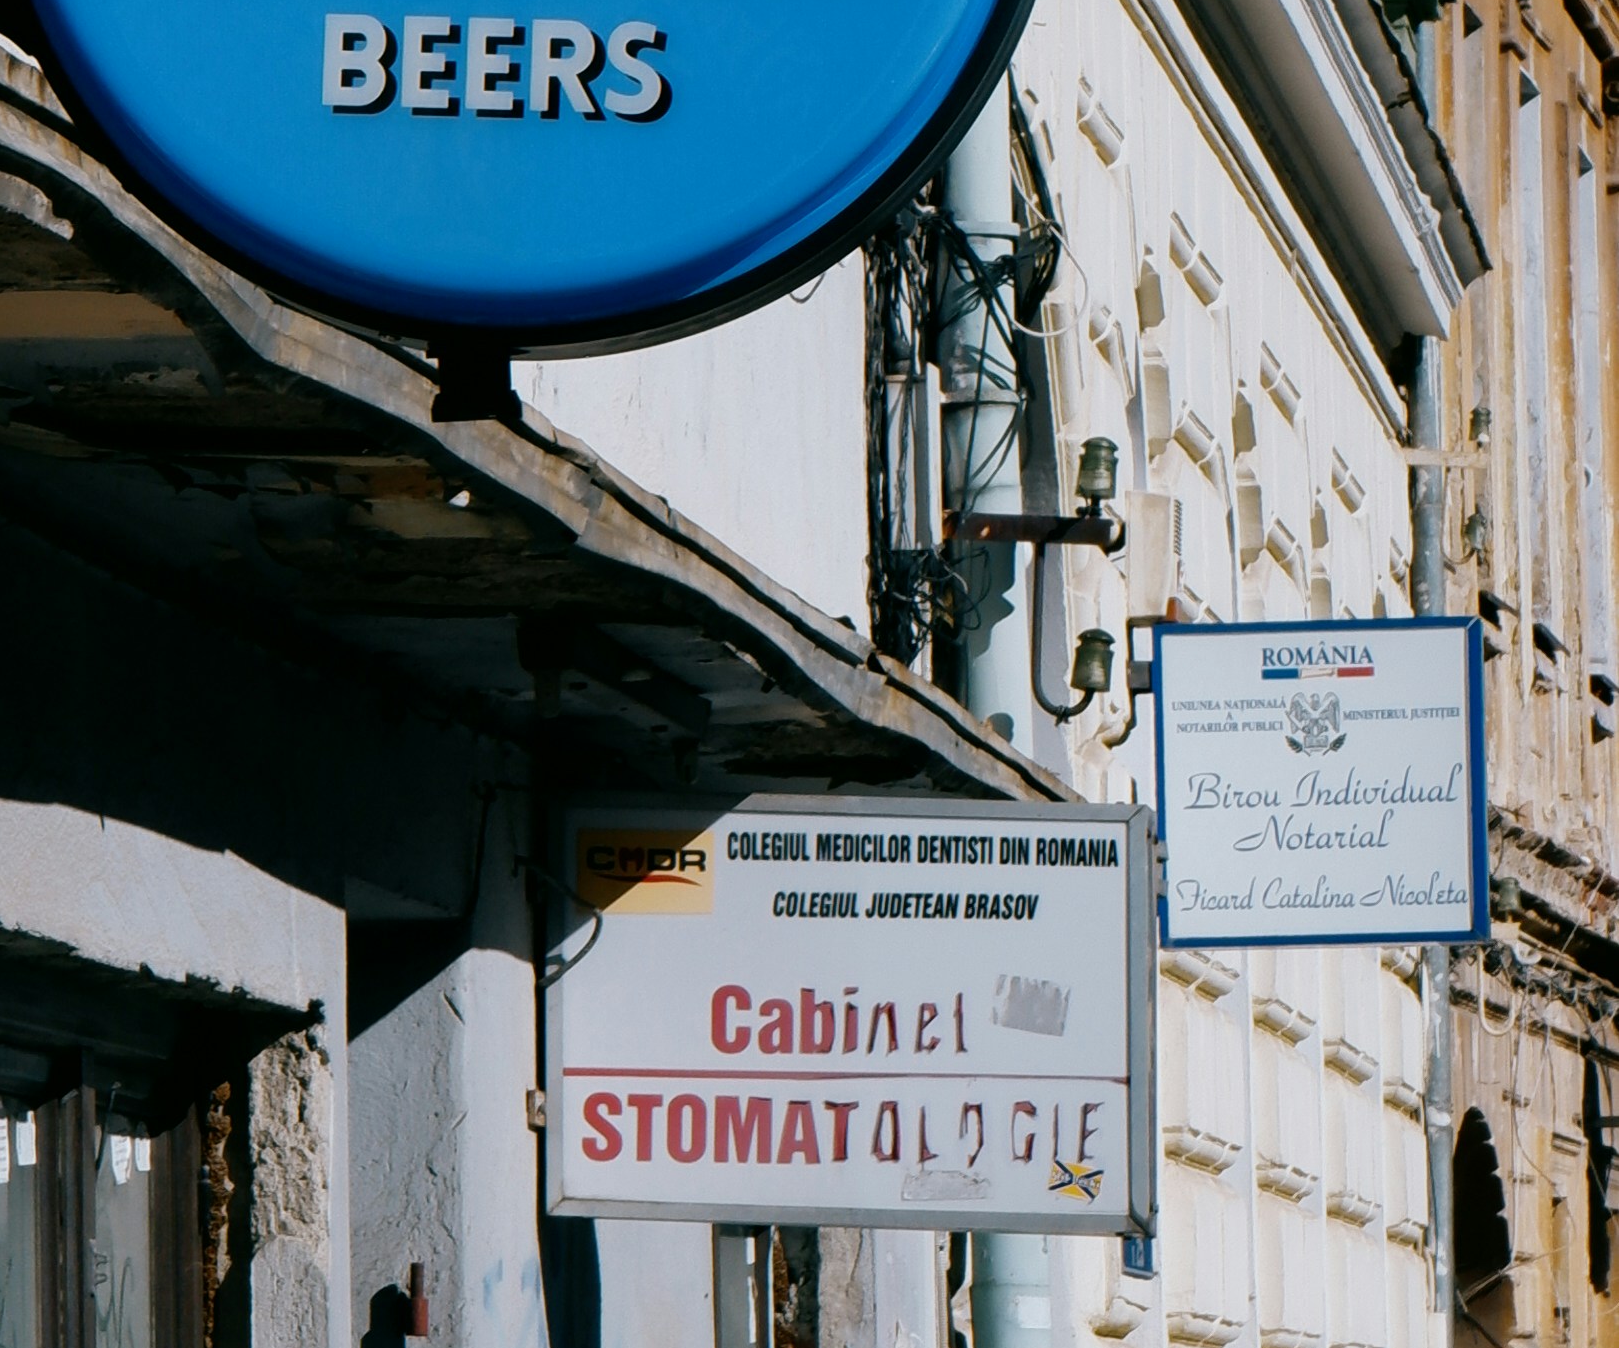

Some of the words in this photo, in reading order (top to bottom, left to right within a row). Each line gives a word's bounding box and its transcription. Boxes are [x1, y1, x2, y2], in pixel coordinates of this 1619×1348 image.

[322, 14, 671, 122] BEERS
[1261, 641, 1374, 668] ROMÂNIA
[1171, 700, 1221, 712] UNIUNEA
[1342, 708, 1409, 721] MINISTERUL
[1176, 721, 1239, 733] NOTARILOR
[1241, 720, 1284, 732] PUBLICI
[1183, 772, 1281, 810] Birou
[1290, 762, 1463, 808] Individual
[1232, 808, 1394, 852] Notarial
[728, 831, 809, 862] COLEGIUL
[816, 833, 912, 865] MEDICILOR
[917, 835, 994, 866] DENTISTI
[999, 837, 1031, 866] DIN
[1036, 837, 1120, 868] ROMANIA
[773, 891, 860, 919] COLEGIUL
[865, 892, 960, 920] JUDETEAN
[964, 894, 1039, 921] BRASOV
[1262, 874, 1355, 910] Catalina
[1359, 870, 1469, 908] Nicoleta
